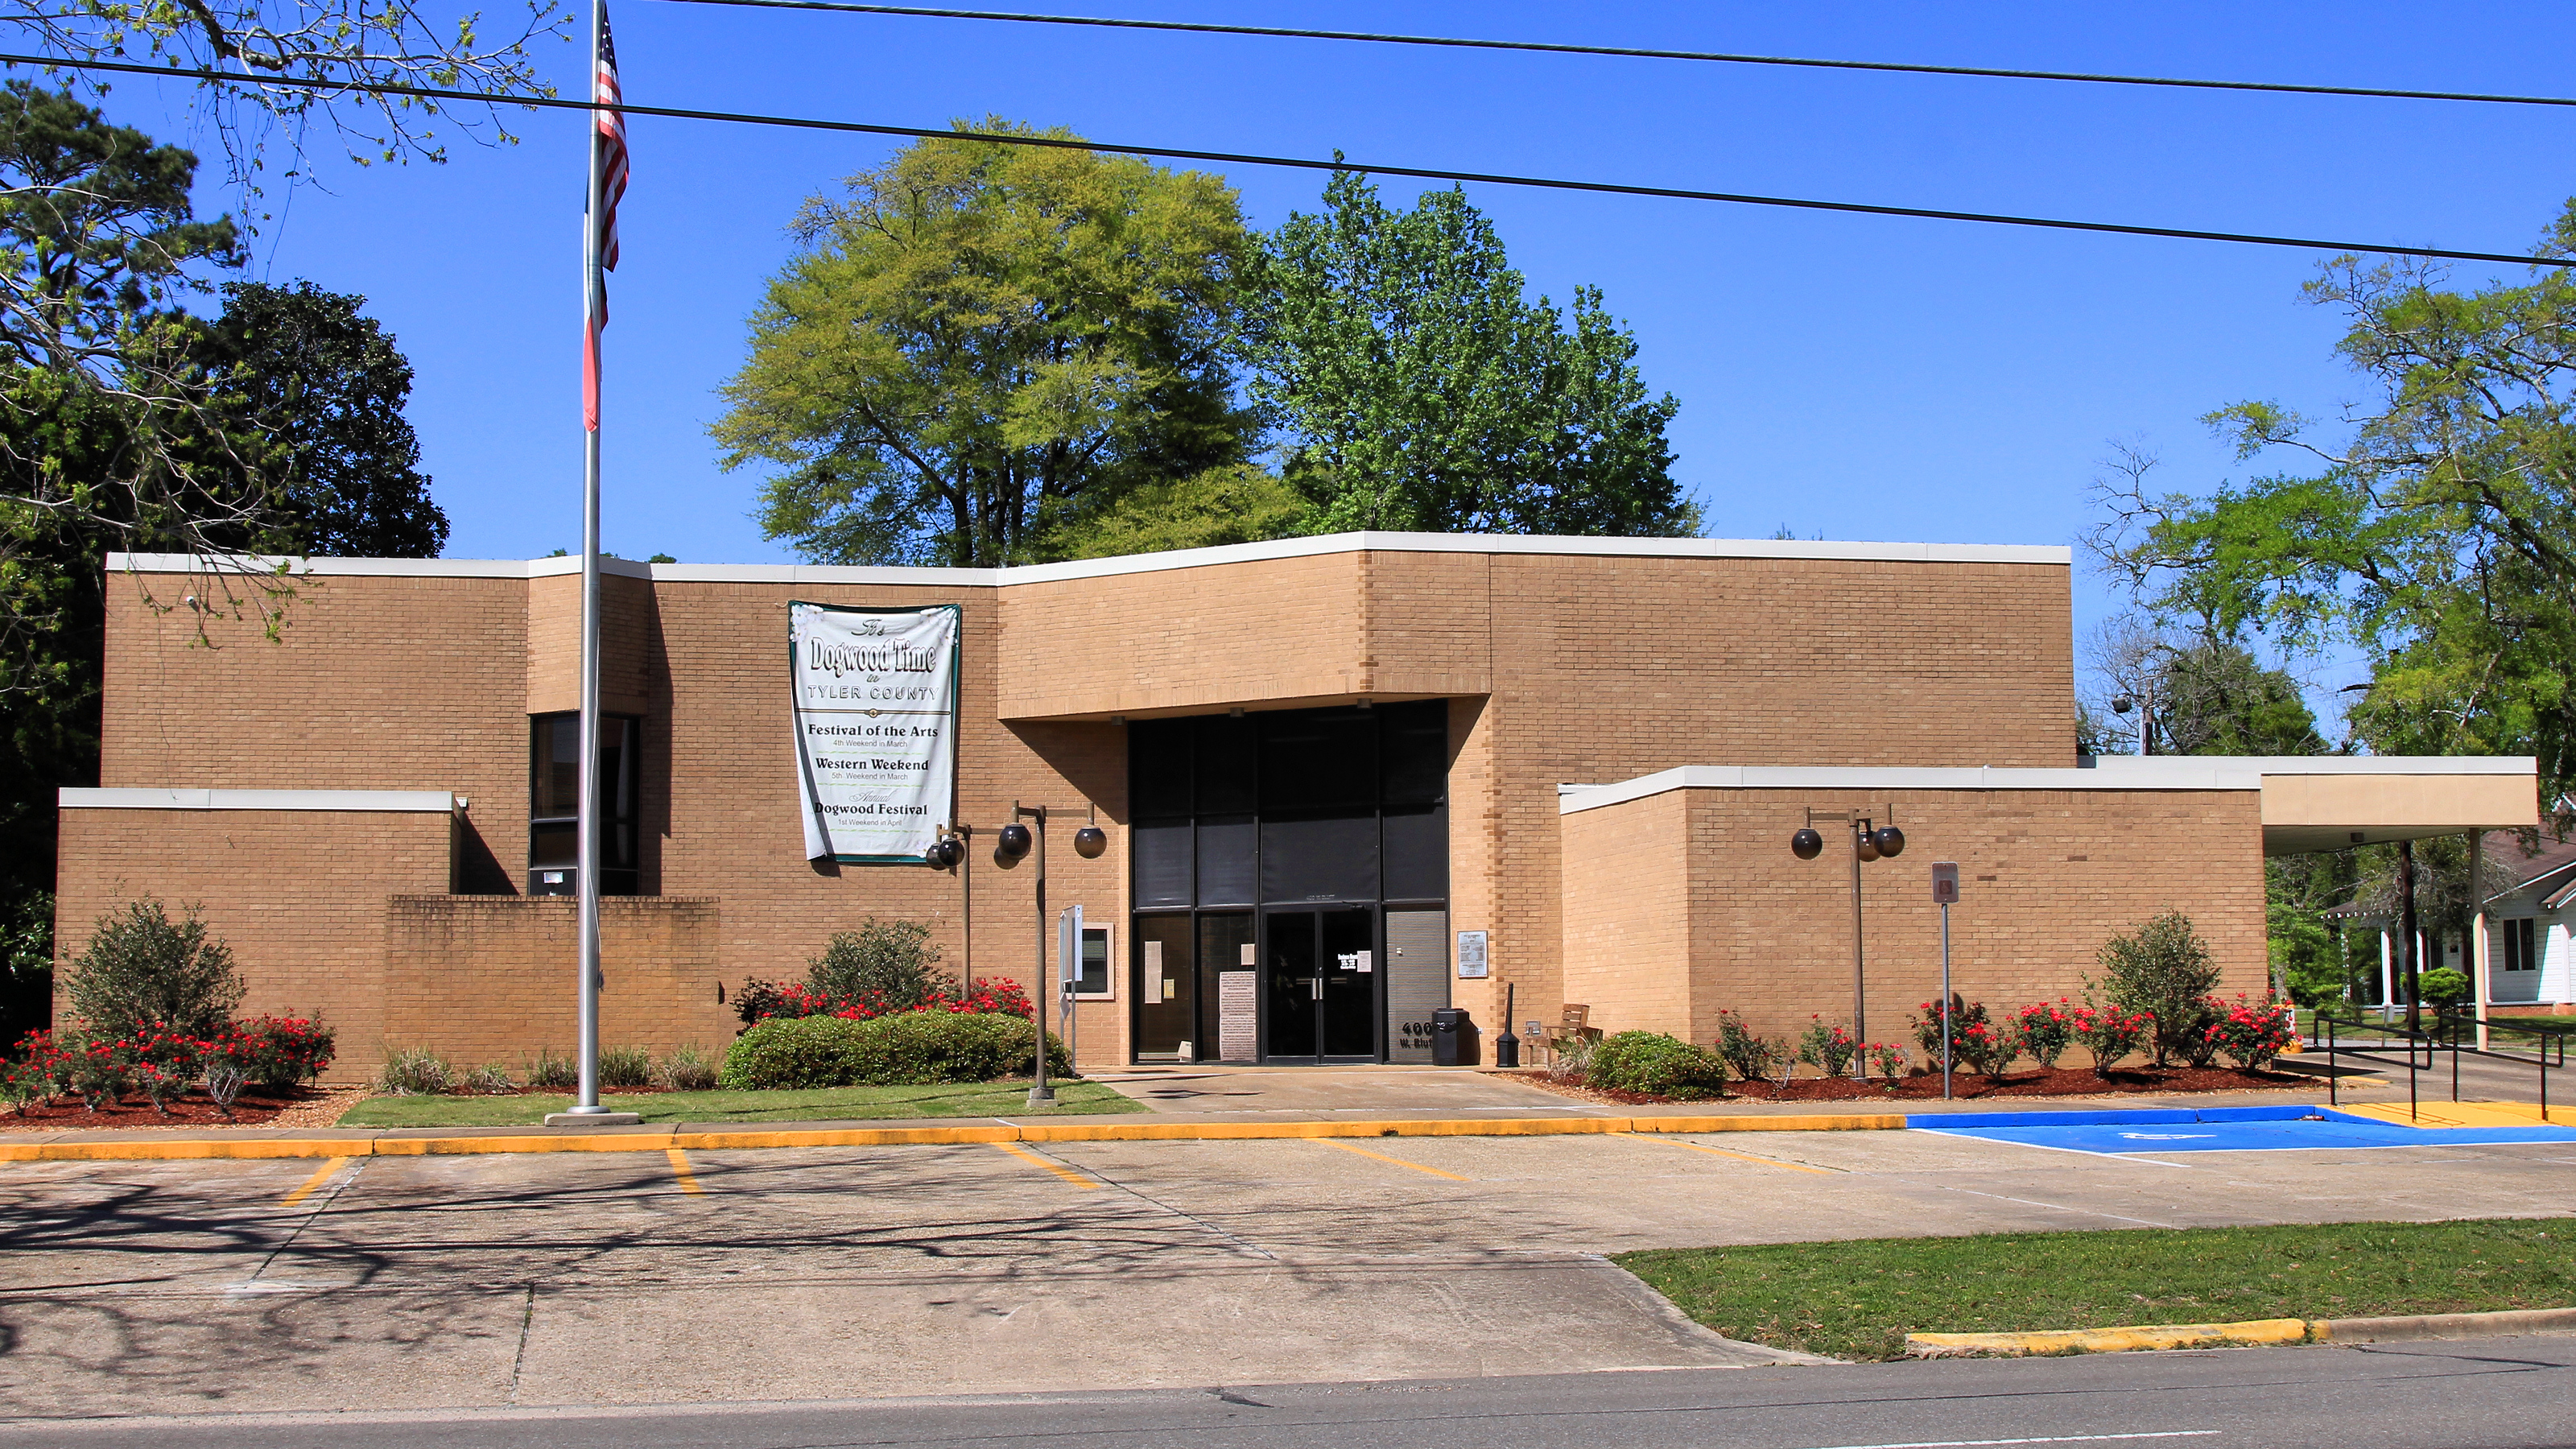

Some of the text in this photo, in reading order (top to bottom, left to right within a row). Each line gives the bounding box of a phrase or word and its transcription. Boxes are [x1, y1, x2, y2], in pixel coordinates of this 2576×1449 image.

[811, 636, 936, 678] Dogwood Time
[866, 674, 881, 683] in
[807, 685, 939, 700] TYLER COUNTY
[808, 724, 939, 738] Festival of the Arts
[832, 739, 908, 748] 4th Weekend in March
[815, 758, 930, 771] Western Weekend
[832, 772, 843, 780] 5th
[845, 772, 878, 780] Weekend
[887, 773, 909, 781] March
[848, 789, 897, 803] Annual
[814, 802, 928, 816] Dogwood Festival
[887, 819, 902, 828] April
[1402, 1022, 1433, 1036] 400
